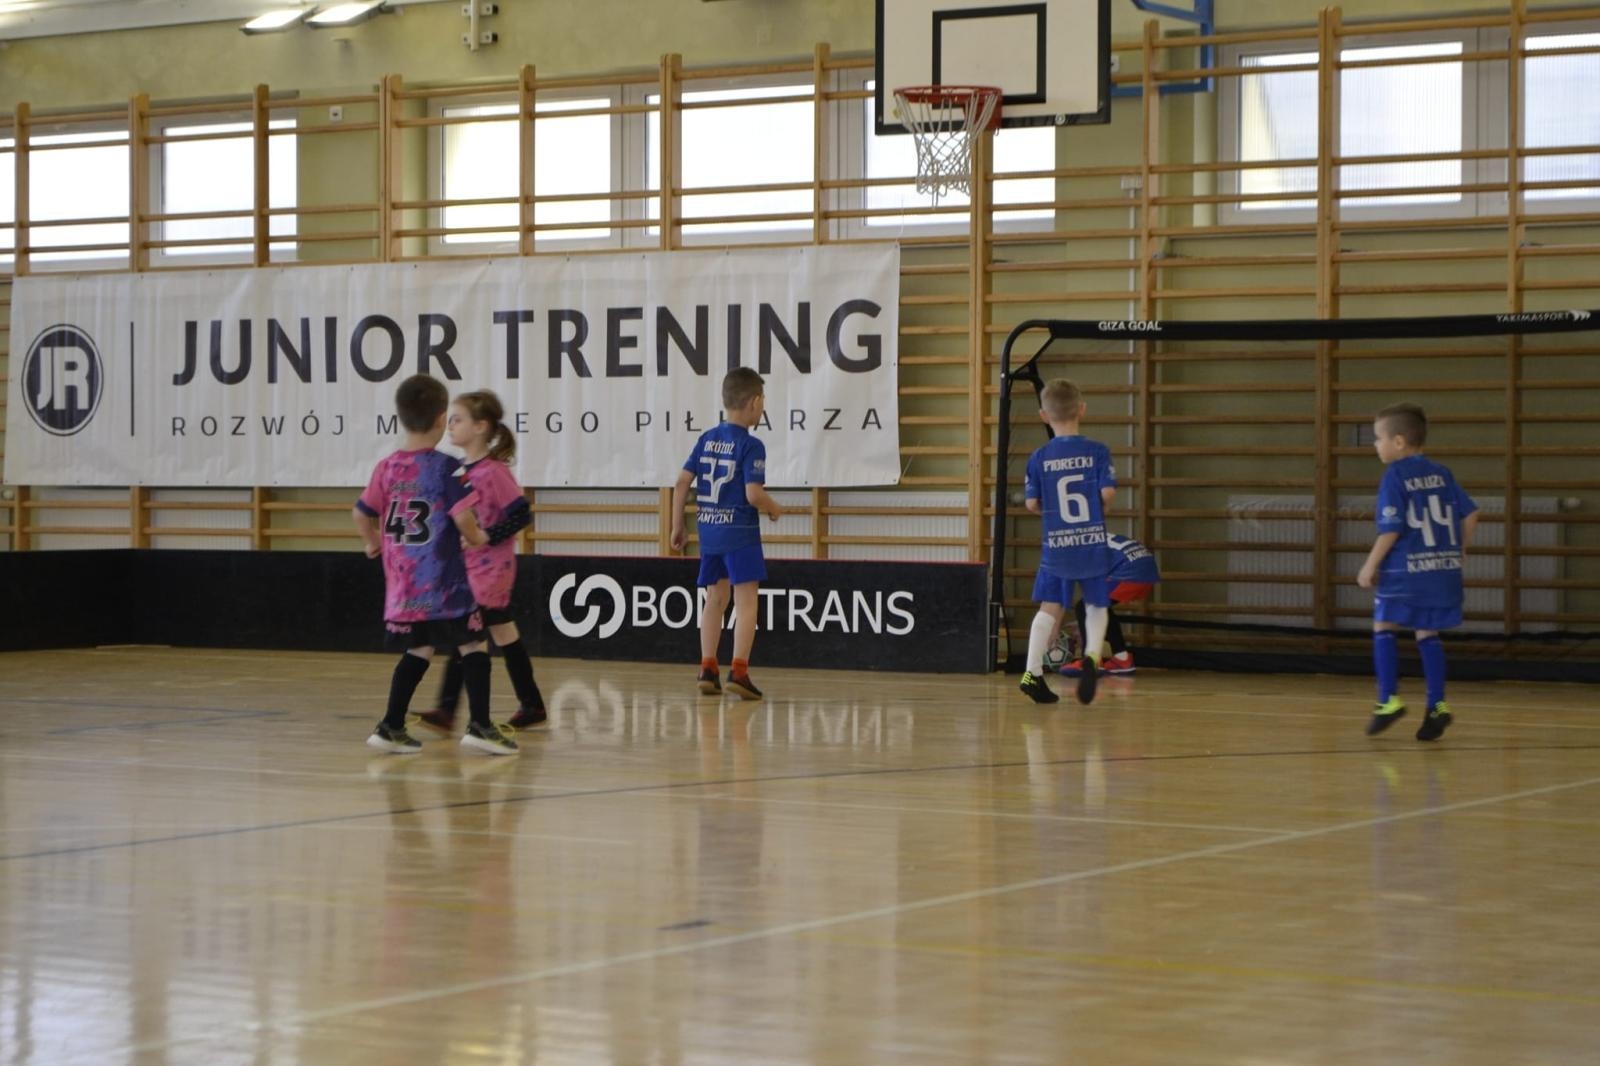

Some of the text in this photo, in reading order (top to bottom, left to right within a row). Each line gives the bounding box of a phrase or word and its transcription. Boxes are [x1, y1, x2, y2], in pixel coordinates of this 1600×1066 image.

[172, 299, 882, 386] JUNIOR TRENING
[1098, 320, 1162, 331] GIZA GOAL
[37, 346, 91, 411] JR
[171, 410, 345, 437] ROZWÓJ
[376, 411, 600, 434] MEGO
[696, 456, 736, 504] 37
[1056, 474, 1090, 524] 6
[384, 499, 434, 545] 43
[1048, 532, 1106, 548] KAMYCZKI
[1406, 494, 1457, 547] 44
